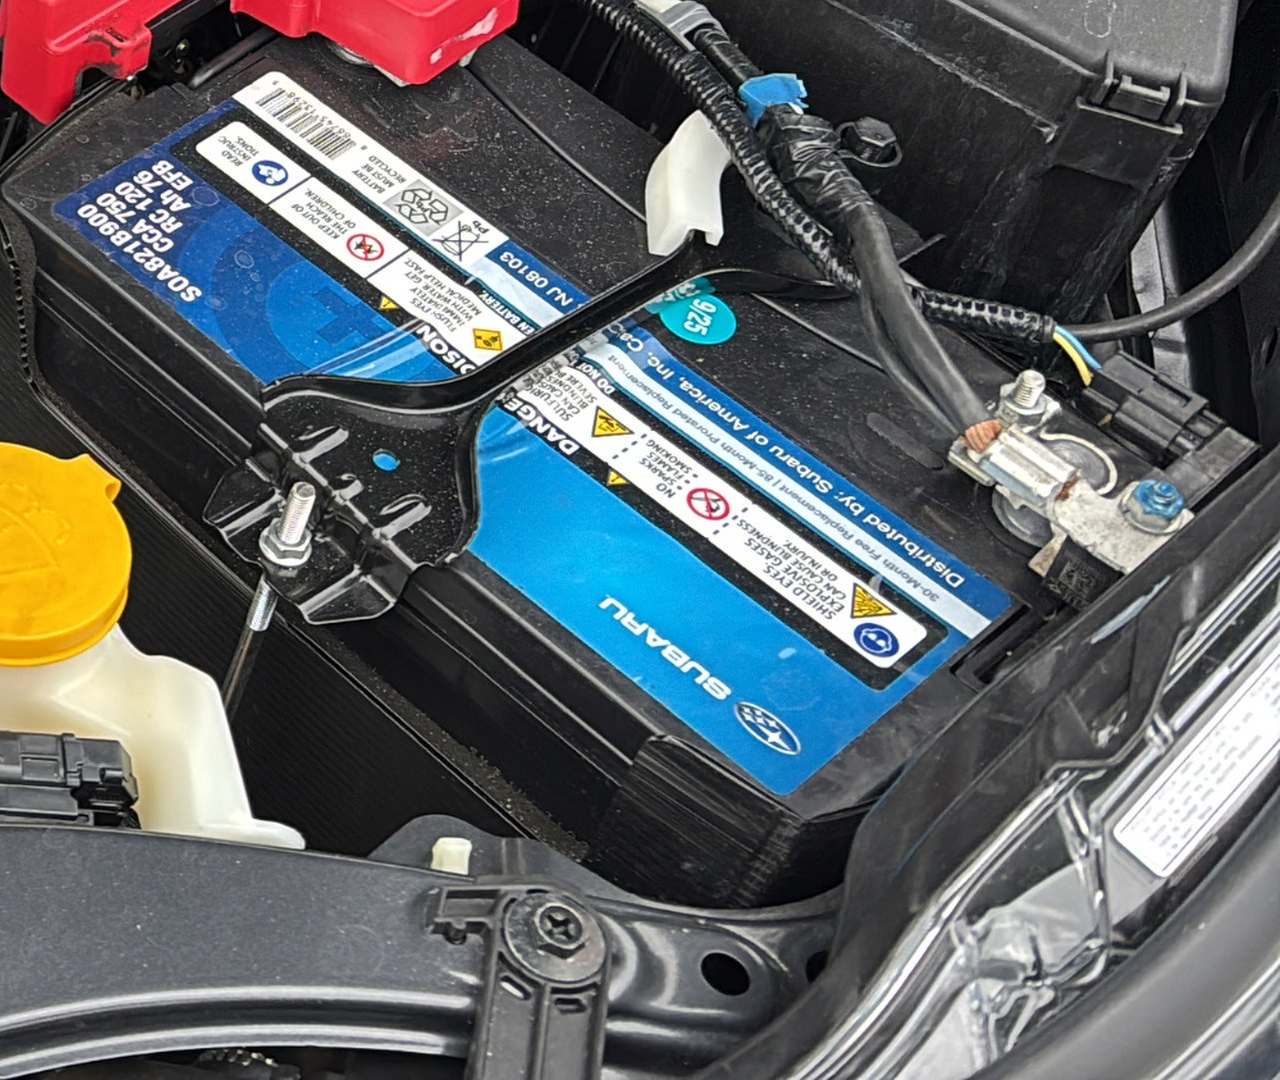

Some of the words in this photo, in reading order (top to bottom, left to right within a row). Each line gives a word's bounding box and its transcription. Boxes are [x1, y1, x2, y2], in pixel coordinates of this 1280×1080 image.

[220, 149, 243, 166] READ
[360, 162, 375, 173] BE
[366, 154, 408, 183] RECYCLED
[130, 168, 164, 193] 76
[149, 158, 194, 191] EFB
[350, 168, 386, 193] BATTERY
[371, 170, 395, 187] MUST
[93, 190, 138, 223] 750
[111, 179, 156, 212] 120
[155, 187, 192, 214] Ah
[289, 202, 305, 213] OF
[301, 187, 346, 220] CHILDREN.
[145, 206, 184, 234] RC
[301, 210, 321, 225] OUT
[304, 201, 333, 223] REACH
[342, 217, 357, 228] OF
[127, 217, 176, 254] CCA
[316, 221, 341, 239] KEEP
[328, 219, 349, 234] THE
[469, 219, 490, 234] Pb
[401, 256, 426, 274] FAST.
[403, 269, 423, 284] GET
[496, 250, 550, 289] 08103
[422, 272, 447, 290] HELP
[408, 296, 431, 314] EYES
[444, 286, 484, 315] MEDICAL
[475, 289, 522, 324] BATTERY.
[544, 285, 574, 306] NJ
[447, 300, 475, 321] WITH
[683, 298, 717, 336] 9/25
[575, 360, 602, 380] NOT
[638, 350, 678, 379] Inc.
[561, 374, 601, 403] SEVERE
[594, 377, 618, 394] DO
[601, 353, 678, 410] Replacement
[558, 397, 581, 414] CAN
[669, 374, 751, 434] America,
[670, 406, 722, 444] Prorated
[743, 428, 770, 448] of
[644, 437, 694, 474] SMOKING
[646, 451, 685, 480] FLAMES
[718, 440, 774, 482] 85-Month
[764, 443, 835, 495] Subaru
[637, 456, 677, 486] SPARKS
[654, 481, 676, 498] NO
[830, 488, 868, 516] by:
[777, 482, 855, 540] Replacement
[734, 517, 792, 561] BLINDNESS
[742, 536, 784, 567] GASES
[851, 537, 882, 561] Free
[860, 511, 966, 589] Distributed
[780, 538, 823, 570] INJURY.
[758, 561, 794, 588] EYES.
[787, 557, 825, 585] CAUSE
[819, 567, 839, 582] OR
[879, 557, 941, 603] 30-Month
[779, 563, 845, 613] EXPLOSIVE
[790, 584, 837, 620] SHIELD
[819, 580, 847, 601] CAN
[597, 593, 734, 703] SUBARU
